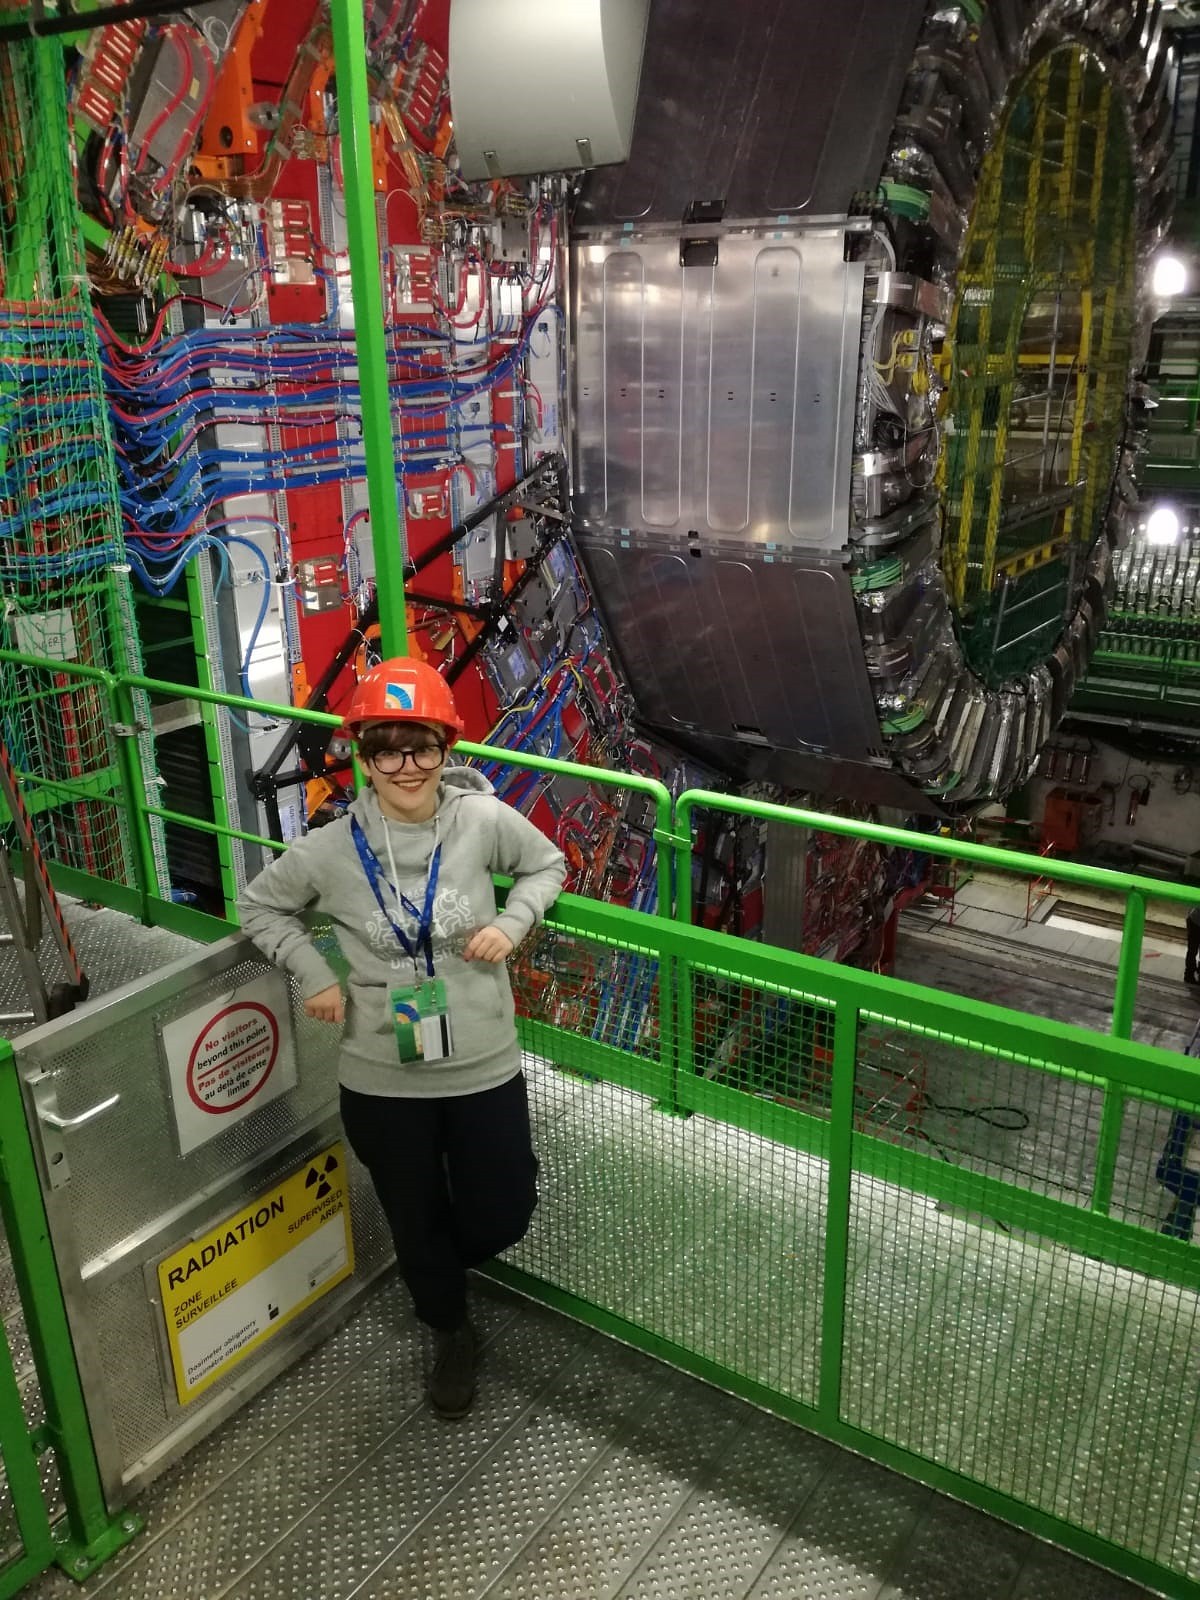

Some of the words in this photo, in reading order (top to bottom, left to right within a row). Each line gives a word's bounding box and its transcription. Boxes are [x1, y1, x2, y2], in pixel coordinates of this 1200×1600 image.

[197, 1046, 228, 1069] beyond
[229, 1036, 245, 1052] this
[246, 1024, 266, 1044] point
[204, 1039, 219, 1052] No
[222, 1018, 258, 1041] visitors
[198, 1077, 216, 1090] Pas
[218, 1068, 230, 1079] de
[232, 1045, 270, 1071] visiteurs
[204, 1090, 215, 1100] au
[217, 1077, 234, 1092] delà
[236, 1069, 246, 1081] de
[247, 1058, 267, 1074] cette
[227, 1079, 250, 1097] limite
[287, 1189, 342, 1233] SUPERVISED
[319, 1202, 343, 1223] AREA
[167, 1195, 285, 1290] RADIATION
[173, 1290, 202, 1316] ZONE
[175, 1278, 238, 1328] SURVEILLÉE
[187, 1345, 222, 1375] Dosimeter
[224, 1319, 257, 1346] obligatory
[189, 1354, 224, 1384] Dosimètre
[225, 1327, 260, 1359] obligatoire
